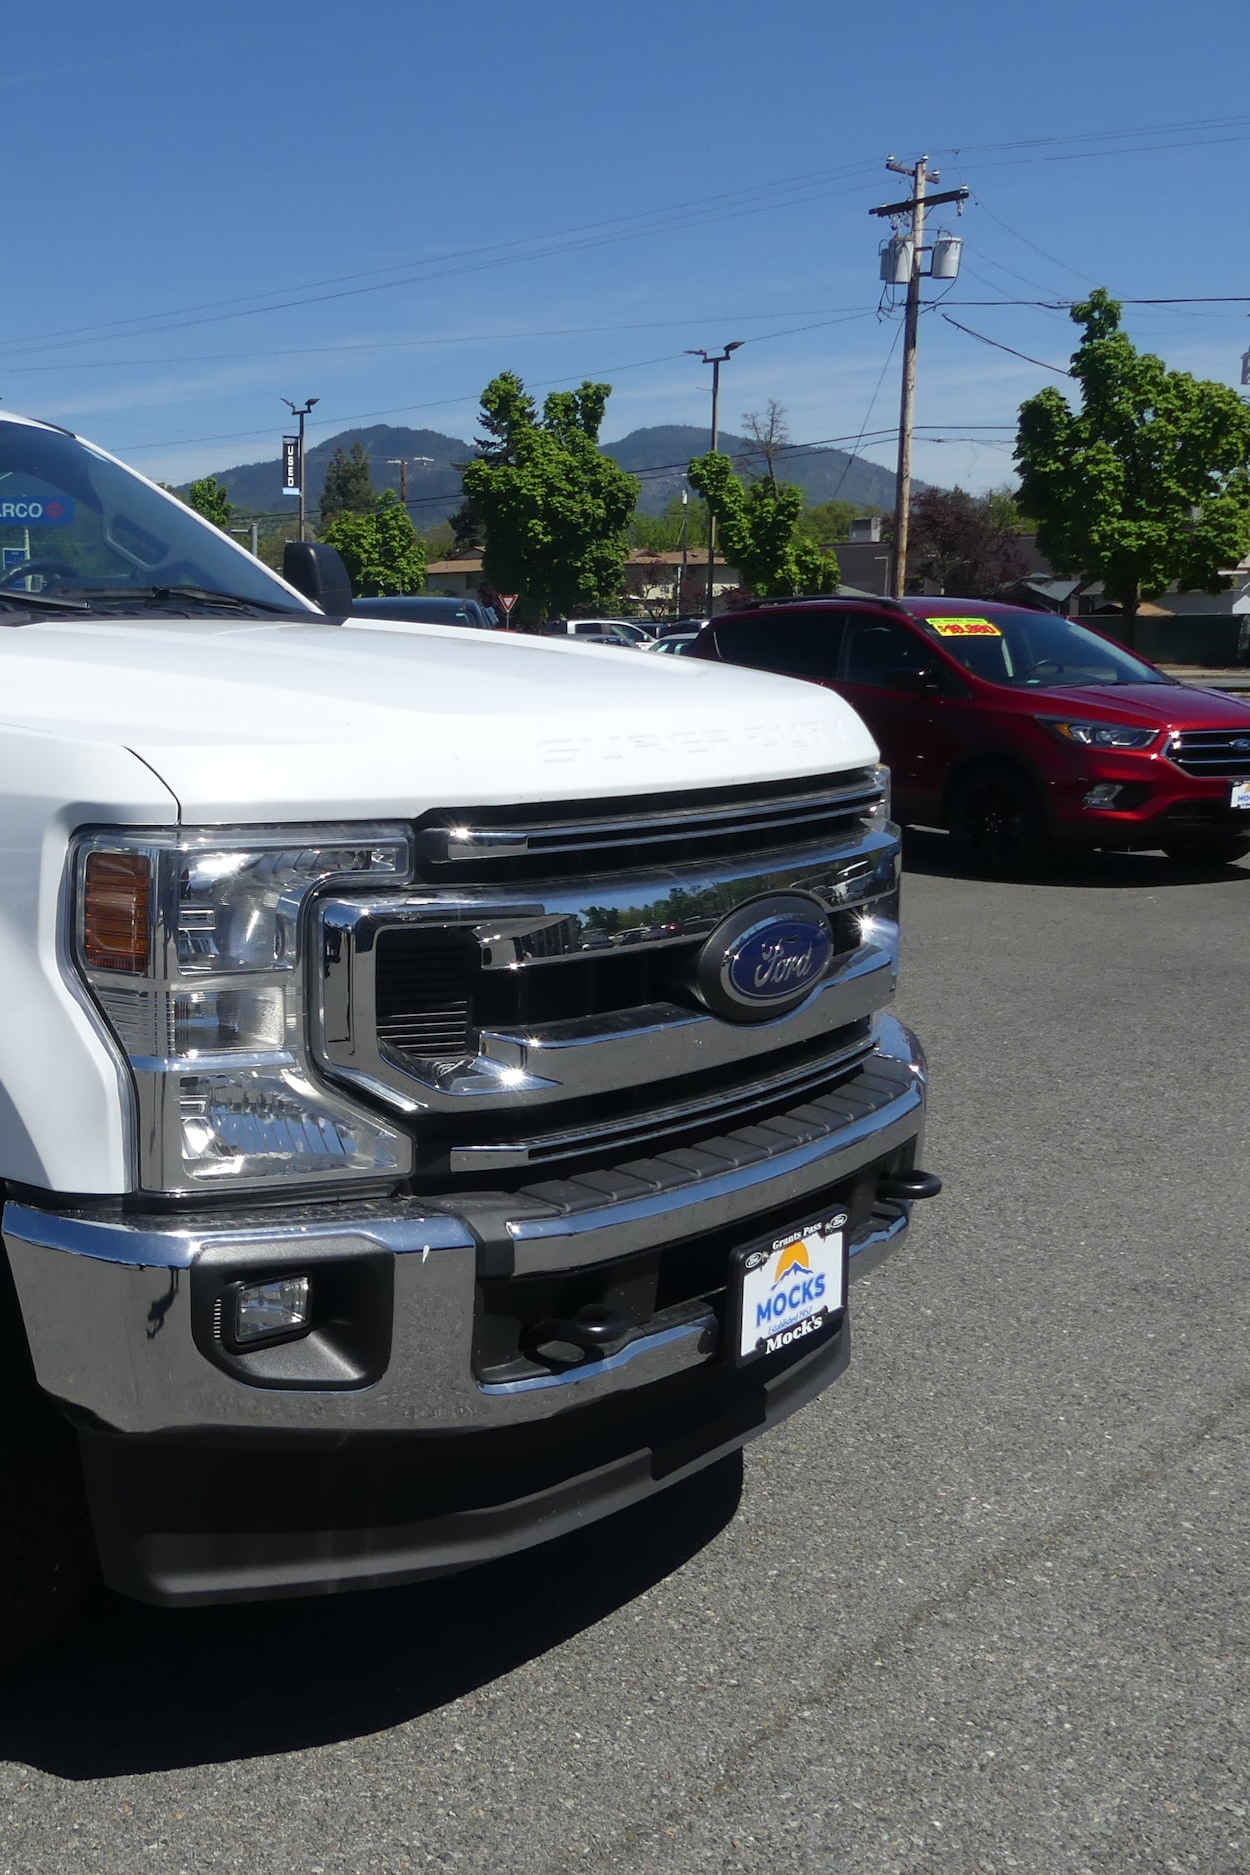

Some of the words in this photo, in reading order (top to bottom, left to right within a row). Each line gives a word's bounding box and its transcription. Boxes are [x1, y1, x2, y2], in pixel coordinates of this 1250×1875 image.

[754, 935, 813, 988] Ford
[772, 1232, 801, 1250] Grants
[803, 1222, 822, 1236] Pass
[756, 1274, 826, 1327] MOCKS
[765, 1314, 823, 1355] Mock's
